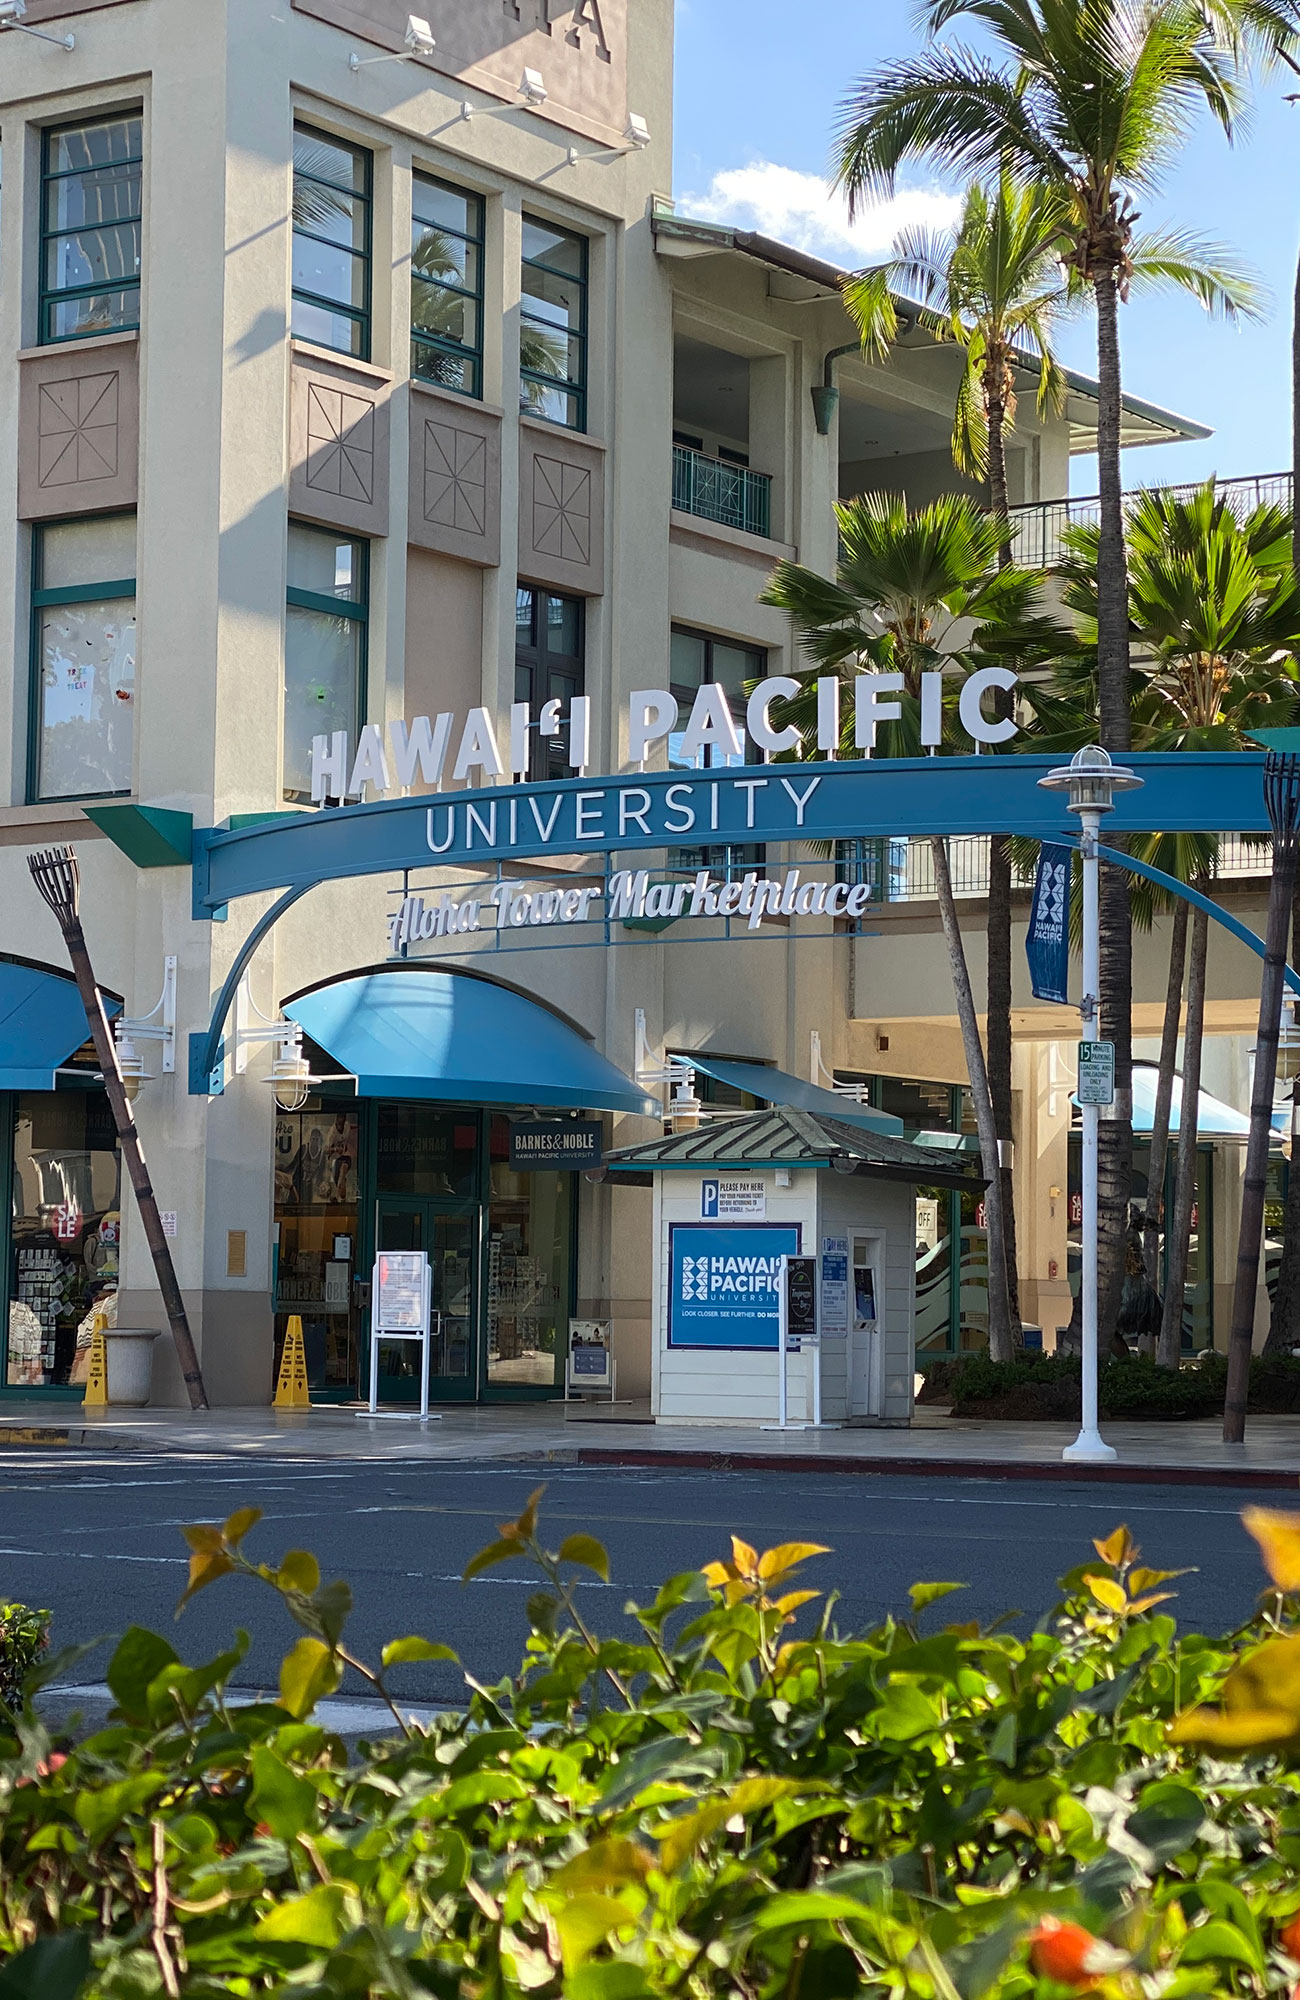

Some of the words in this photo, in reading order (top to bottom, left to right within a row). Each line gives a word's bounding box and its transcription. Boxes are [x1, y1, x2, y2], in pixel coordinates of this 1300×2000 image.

[629, 667, 1019, 762] PACIFIC
[427, 777, 822, 853] UNIVERSITY
[388, 893, 482, 951] Aloha
[490, 880, 601, 930] Tower
[608, 869, 872, 930] Marketplace
[1033, 930, 1062, 941] PACIFIC
[1080, 1044, 1091, 1060] 15
[1093, 1045, 1110, 1053] MINUTE
[1091, 1053, 1112, 1061] PARKING
[1080, 1063, 1100, 1071] LOADING
[1102, 1064, 1112, 1072] AND
[276, 1121, 293, 1134] Are
[515, 1133, 594, 1150] BARNES&NOBLE
[560, 1151, 595, 1159] UNIVERSITY
[720, 1182, 739, 1192] PLEASE
[740, 1182, 750, 1192] PAY
[751, 1182, 764, 1192] HERE
[704, 1184, 717, 1215] P
[918, 1212, 931, 1226] OFF
[711, 1257, 780, 1274] HAWAI‘
[711, 1294, 777, 1302] UNIVERSIT
